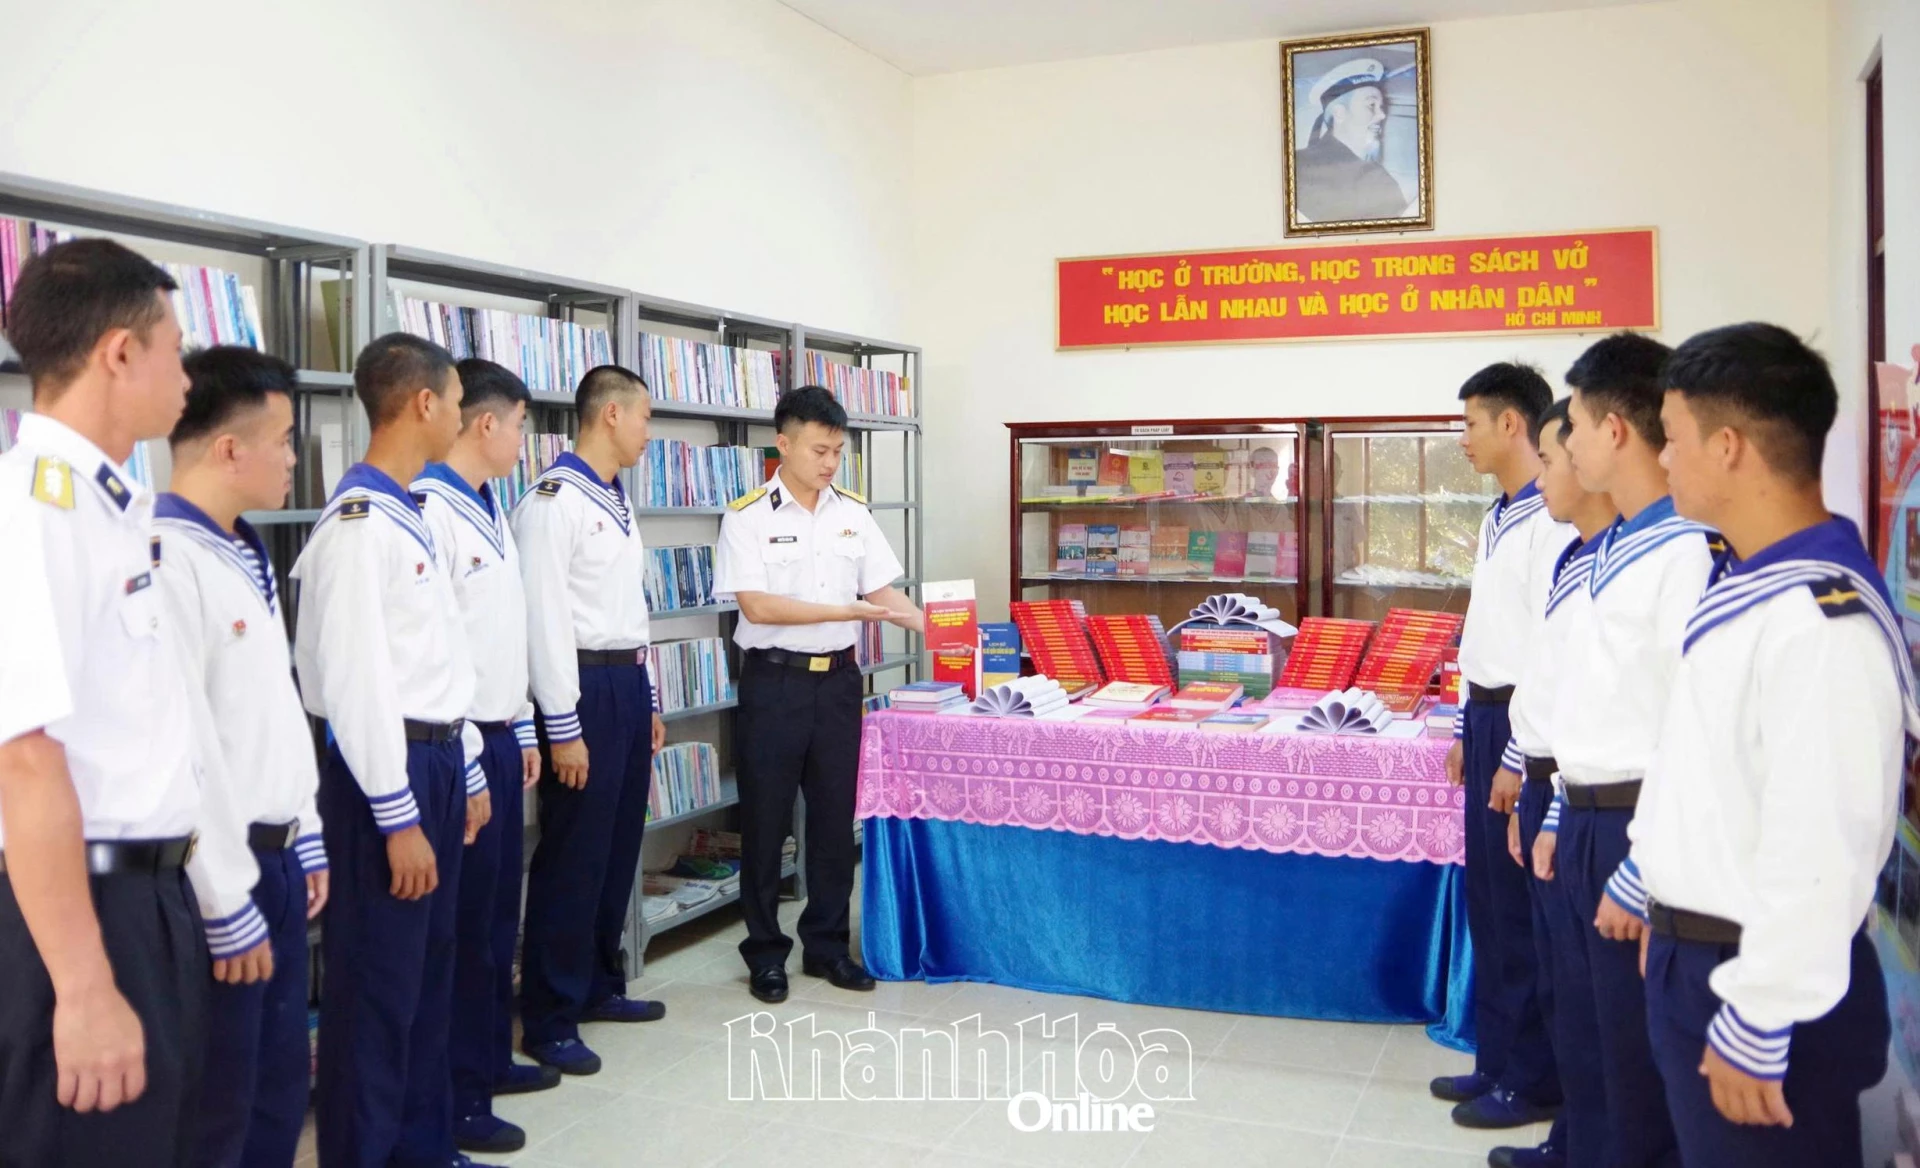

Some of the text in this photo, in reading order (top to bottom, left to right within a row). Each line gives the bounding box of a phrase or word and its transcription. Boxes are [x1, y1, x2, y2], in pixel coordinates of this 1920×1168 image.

[1118, 268, 1164, 292] HỌC
[1174, 260, 1191, 287] Ở
[1200, 258, 1305, 284] TRƯỜNG,
[1311, 259, 1360, 284] HỌC
[1371, 254, 1455, 278] TRONG
[1469, 247, 1539, 273] SÁCH
[1553, 240, 1589, 270] VỞ
[1104, 303, 1149, 327] HỌC
[1160, 294, 1208, 322] LẪN
[1220, 297, 1287, 320] NHAU
[1298, 291, 1329, 316] VÀ
[1339, 292, 1389, 318] HỌC
[1401, 283, 1419, 312] Ở
[1430, 284, 1505, 312] NHÂN
[1517, 281, 1575, 308] DÂN
[1505, 308, 1602, 327] HỒ CHÍ MINH
